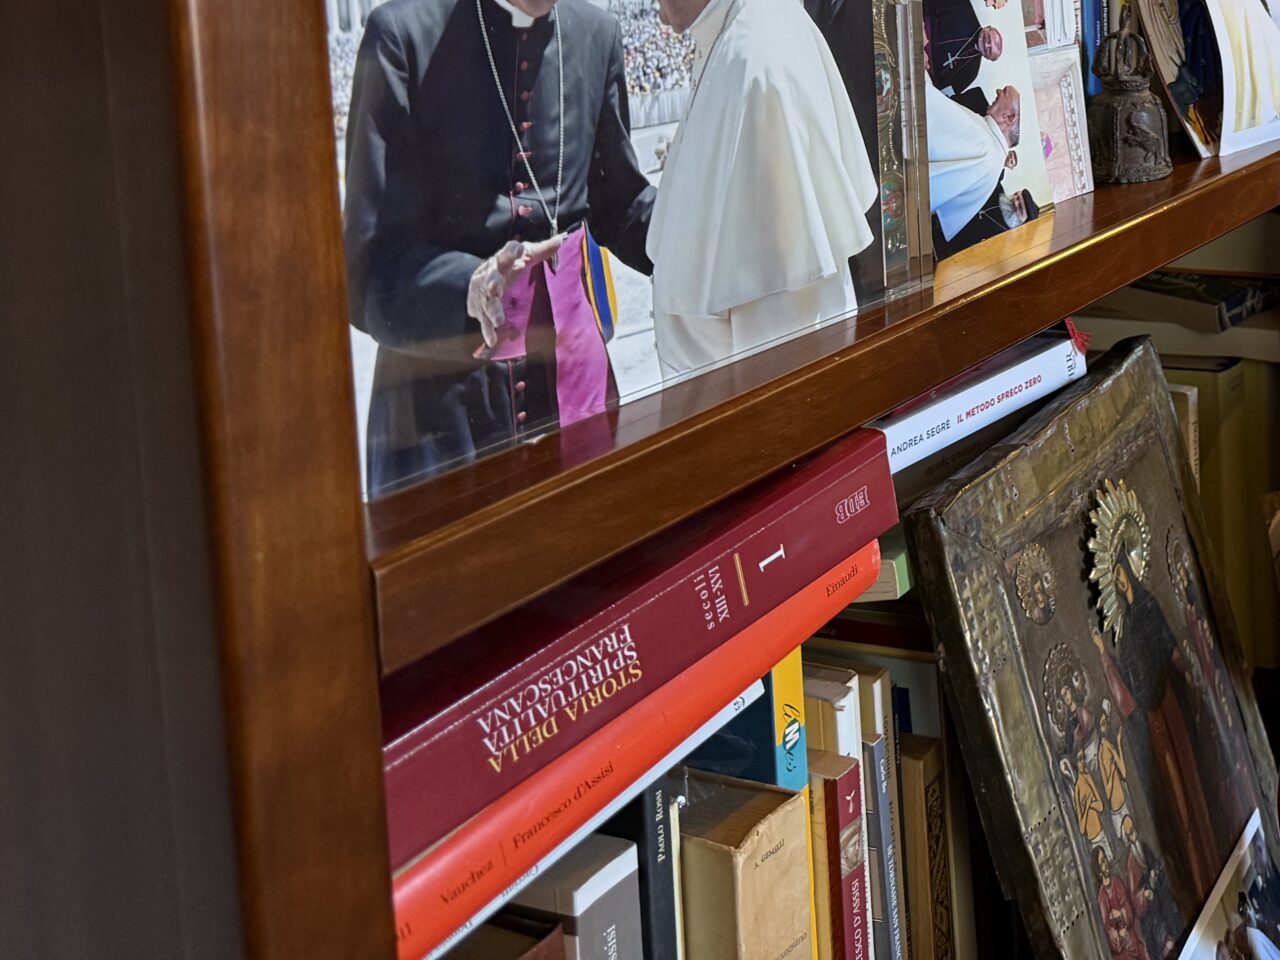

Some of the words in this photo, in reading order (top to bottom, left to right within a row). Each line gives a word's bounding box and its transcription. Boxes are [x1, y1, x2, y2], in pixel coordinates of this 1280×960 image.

[891, 434, 924, 457] ANDREA
[956, 414, 965, 425] IL
[966, 397, 995, 420] METODO
[997, 385, 1023, 404] SPRECO
[1024, 374, 1042, 390] ZERO
[835, 486, 871, 524] EDB
[693, 575, 716, 630] secoli
[708, 565, 730, 622] XIII-XVI
[477, 623, 633, 734] FRANCESCANA
[564, 660, 643, 722] STORIA
[440, 860, 494, 906] Vauchez
[512, 799, 571, 849] Francesco
[574, 760, 614, 802] d'Assisi
[825, 563, 858, 597] Einaudi
[488, 715, 560, 774] DELLA
[656, 824, 666, 863] PAOLO
[886, 844, 892, 857] SE
[850, 877, 862, 927] D'ASSISI
